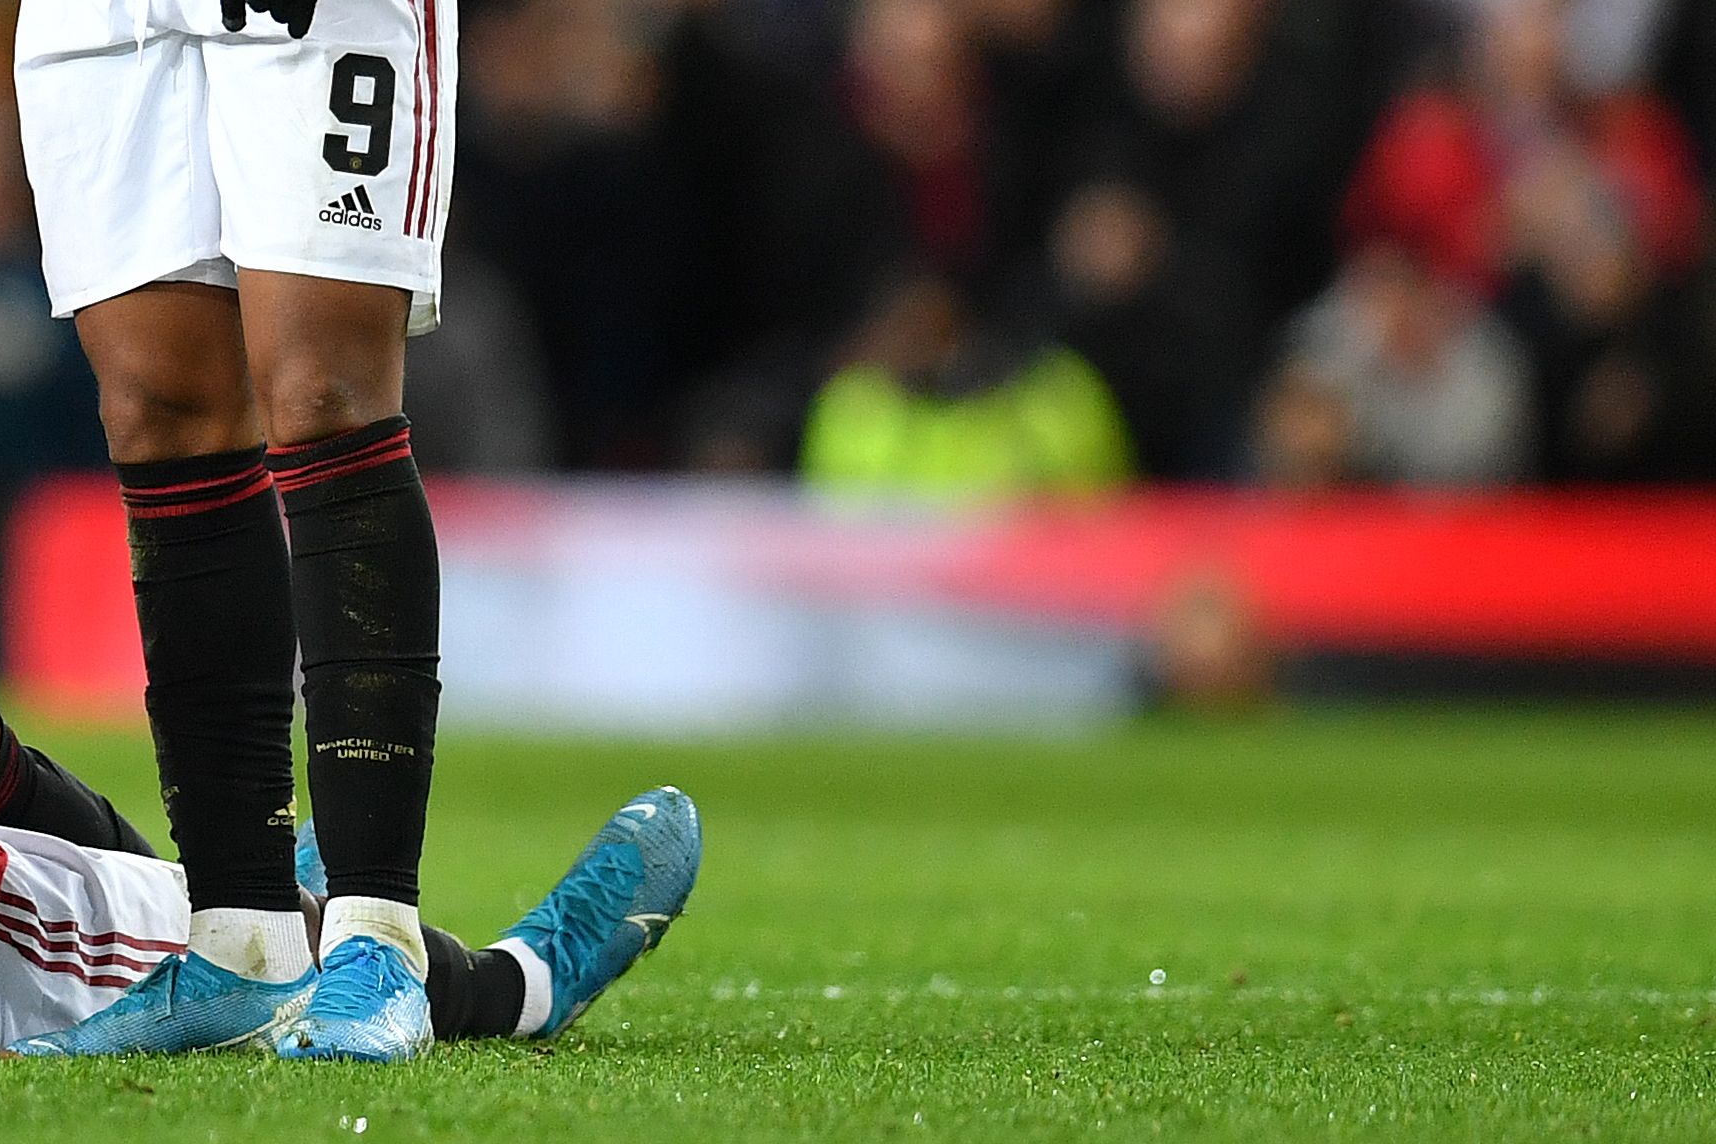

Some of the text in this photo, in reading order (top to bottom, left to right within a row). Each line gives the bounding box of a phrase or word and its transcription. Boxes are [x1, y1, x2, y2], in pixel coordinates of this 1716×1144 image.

[322, 52, 396, 177] 9
[318, 208, 382, 231] adidas
[337, 748, 391, 761] UNITED
